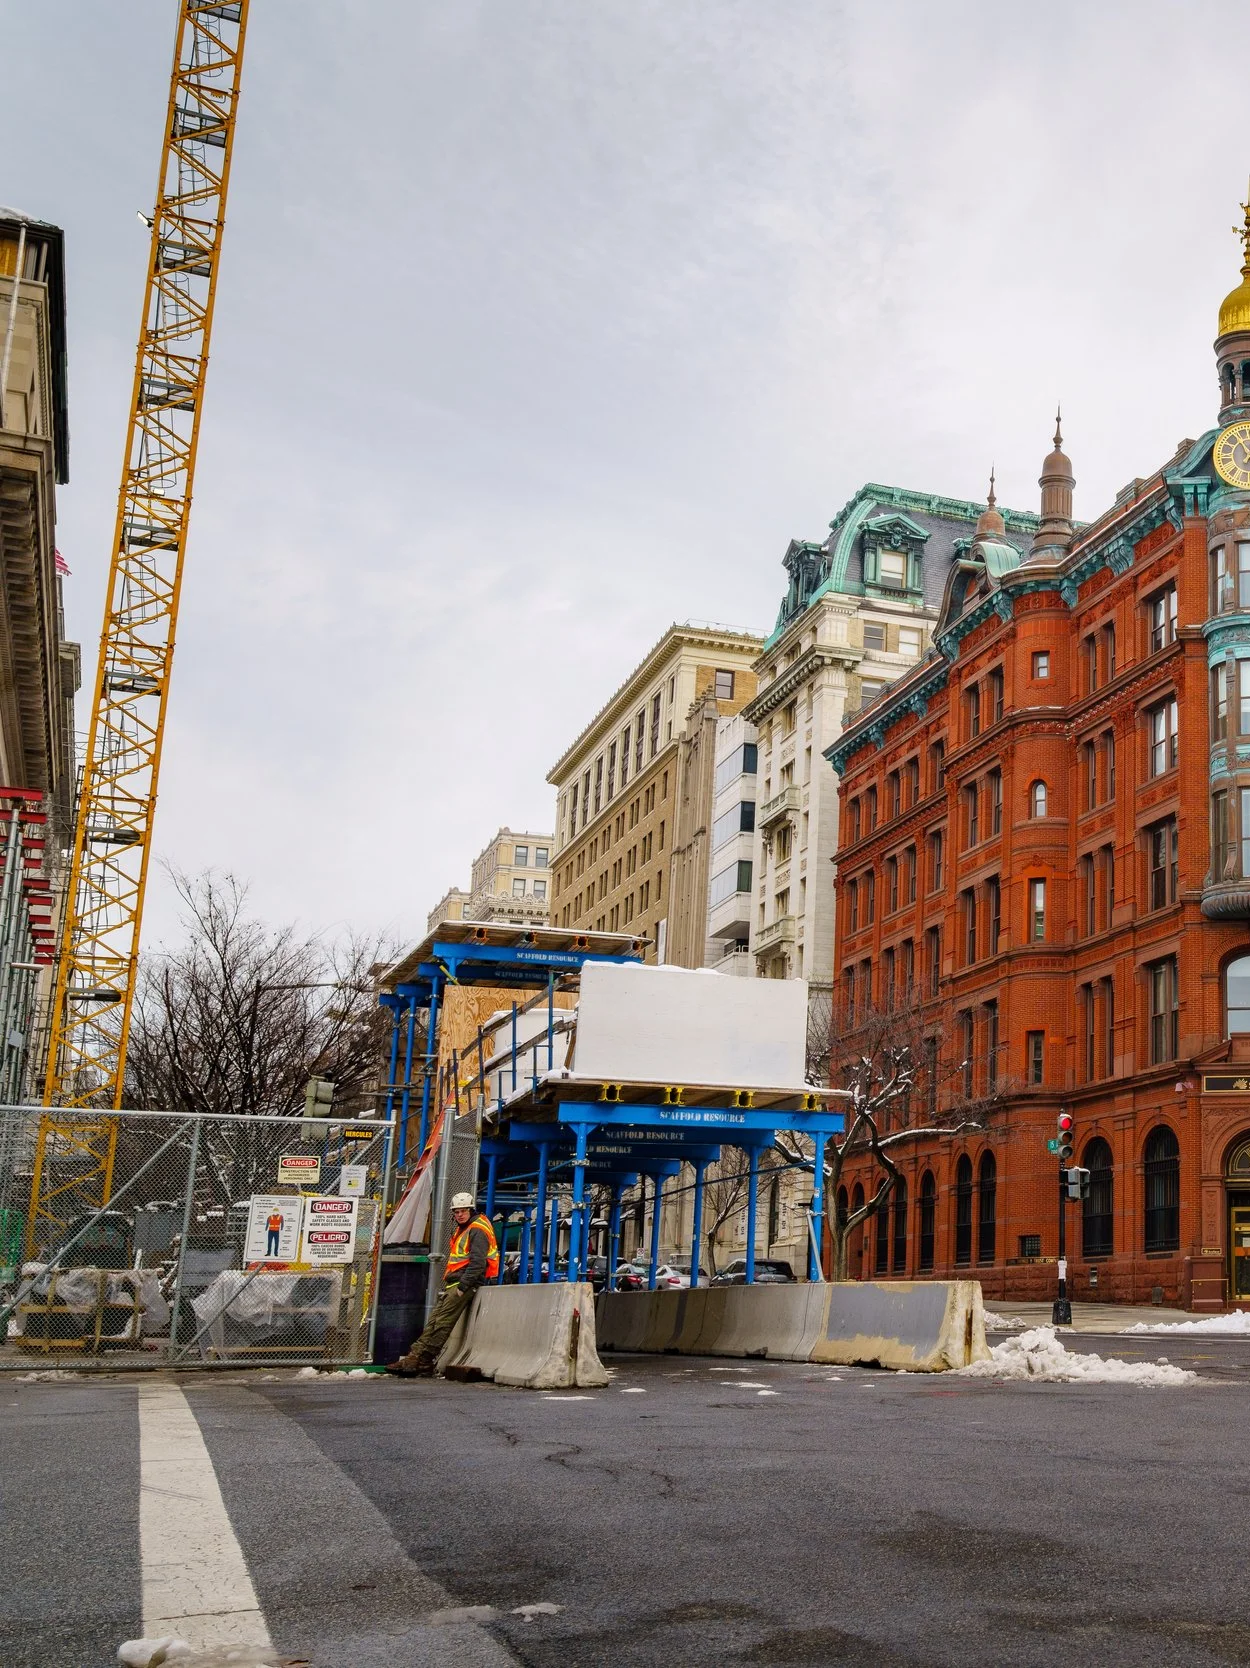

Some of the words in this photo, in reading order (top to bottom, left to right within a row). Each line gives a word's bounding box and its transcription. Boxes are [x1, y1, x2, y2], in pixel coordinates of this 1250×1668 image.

[548, 954, 579, 962] RESOURCE
[660, 1112, 700, 1121] SCAFFOLD
[703, 1113, 745, 1122] RESOURCE
[606, 1131, 644, 1139] SCAFFOLD
[646, 1132, 684, 1140] RESOURCE
